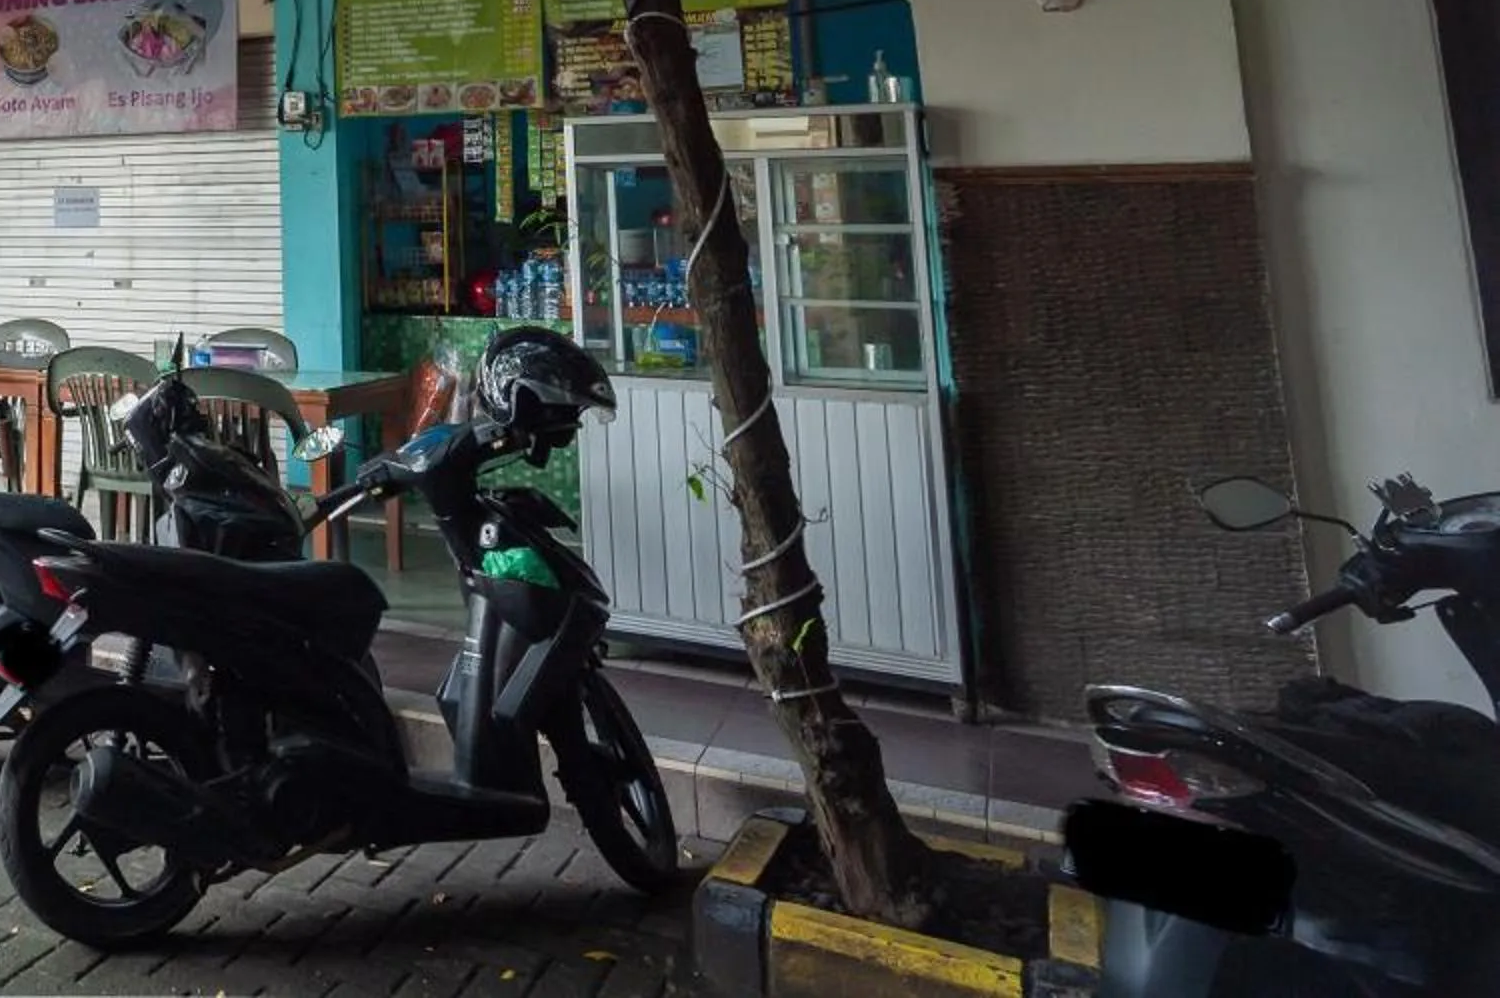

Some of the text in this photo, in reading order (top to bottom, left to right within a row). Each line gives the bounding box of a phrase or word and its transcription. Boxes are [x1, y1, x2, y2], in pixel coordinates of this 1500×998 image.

[31, 94, 76, 114] Ayam
[108, 87, 214, 110] Es Pisang Ijo
